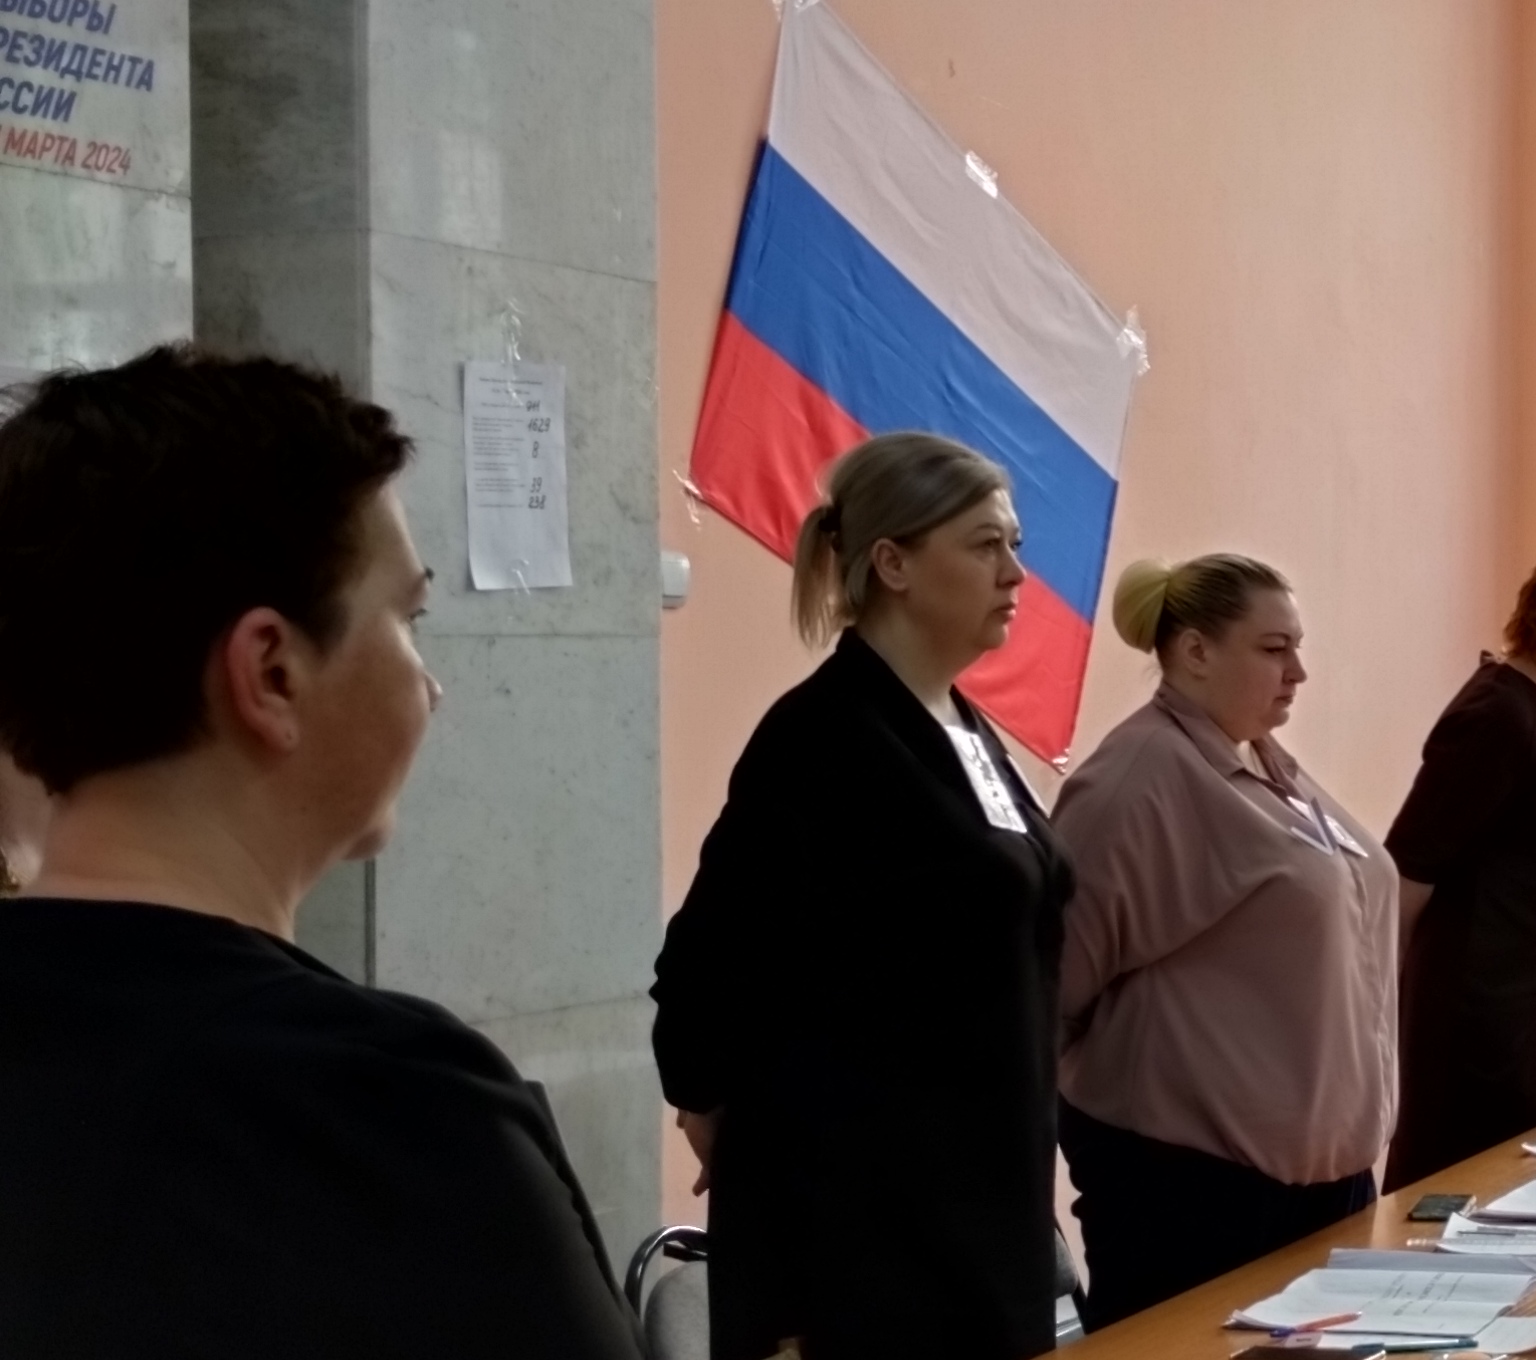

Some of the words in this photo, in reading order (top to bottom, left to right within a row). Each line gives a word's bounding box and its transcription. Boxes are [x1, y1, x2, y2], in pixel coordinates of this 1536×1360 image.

[0, 76, 77, 123] ССИИ
[3, 126, 78, 167] МАРТА
[81, 141, 131, 176] 2024
